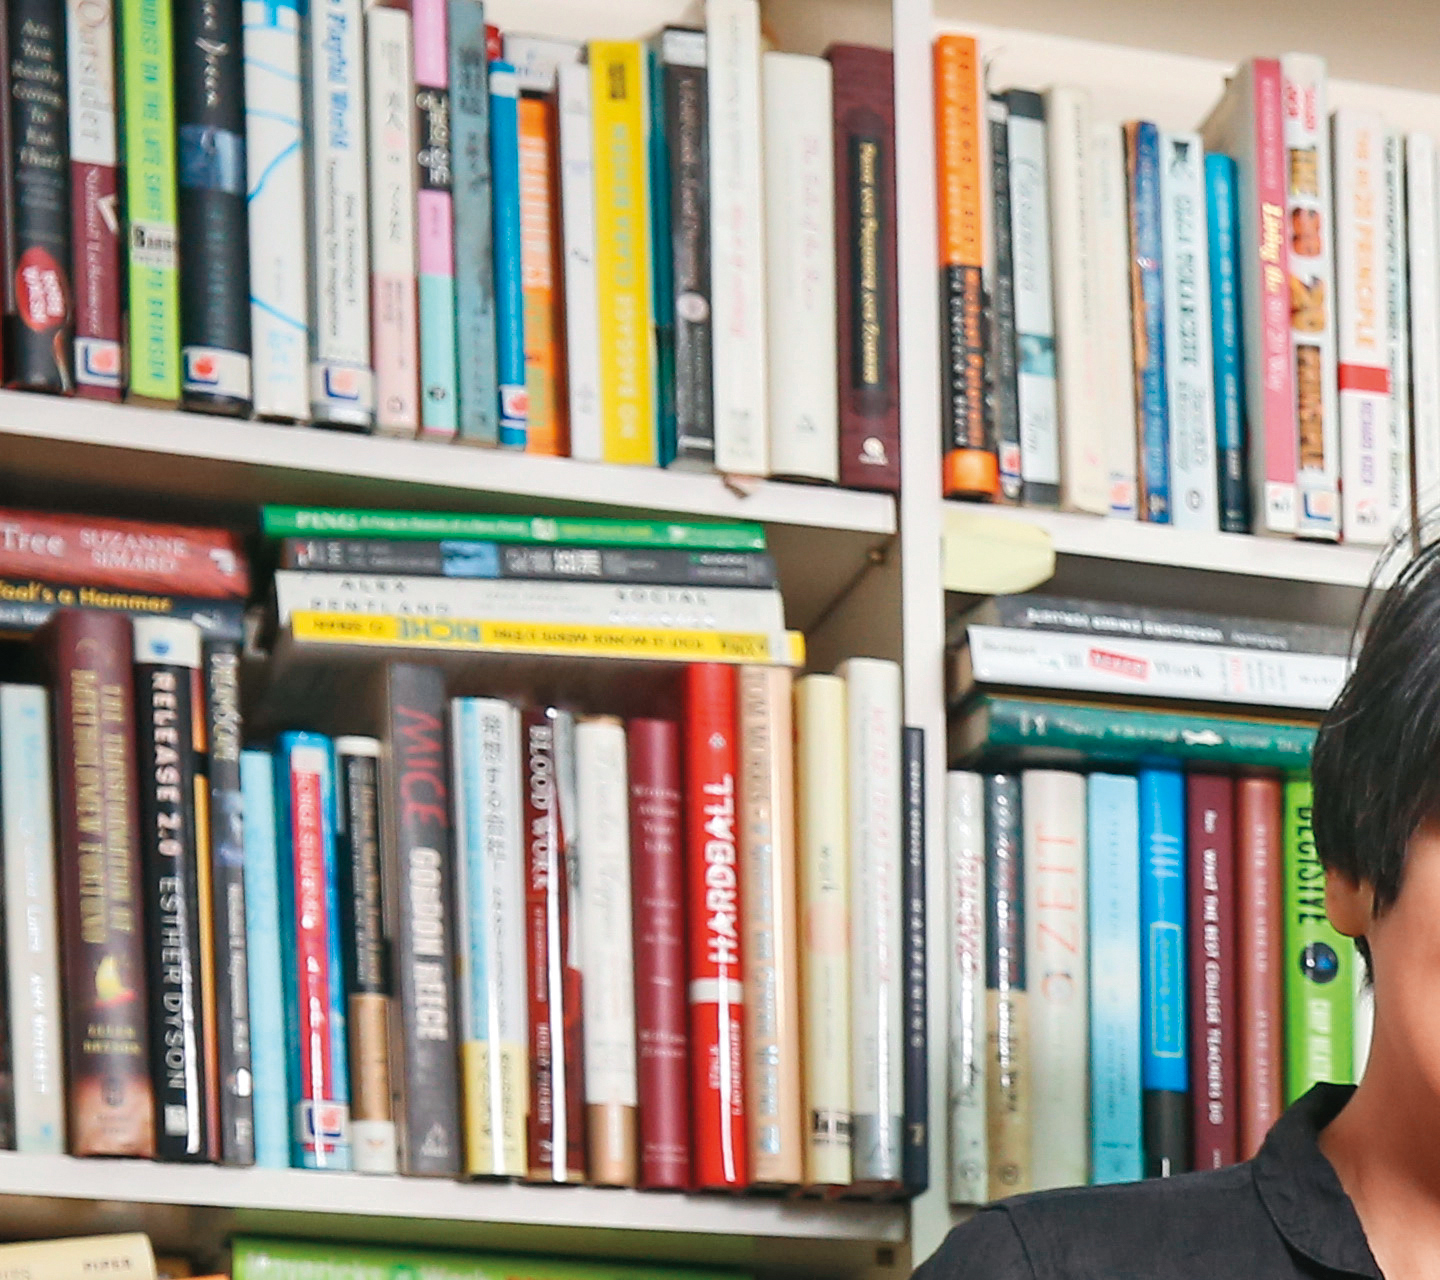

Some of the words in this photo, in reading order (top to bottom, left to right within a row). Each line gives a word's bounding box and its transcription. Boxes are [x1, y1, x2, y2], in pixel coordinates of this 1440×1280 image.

[1, 523, 67, 558] Tree
[79, 528, 190, 556] SUZANNE
[91, 549, 179, 573] SIMARD
[79, 586, 174, 613] Hammer
[151, 671, 182, 806] RELEASE
[393, 703, 449, 830] MICE
[529, 725, 556, 812] BLOOD
[530, 816, 557, 893] WORK
[703, 771, 739, 964] HARDBALL
[160, 876, 187, 984] ESTHER
[163, 991, 189, 1090] DYSON
